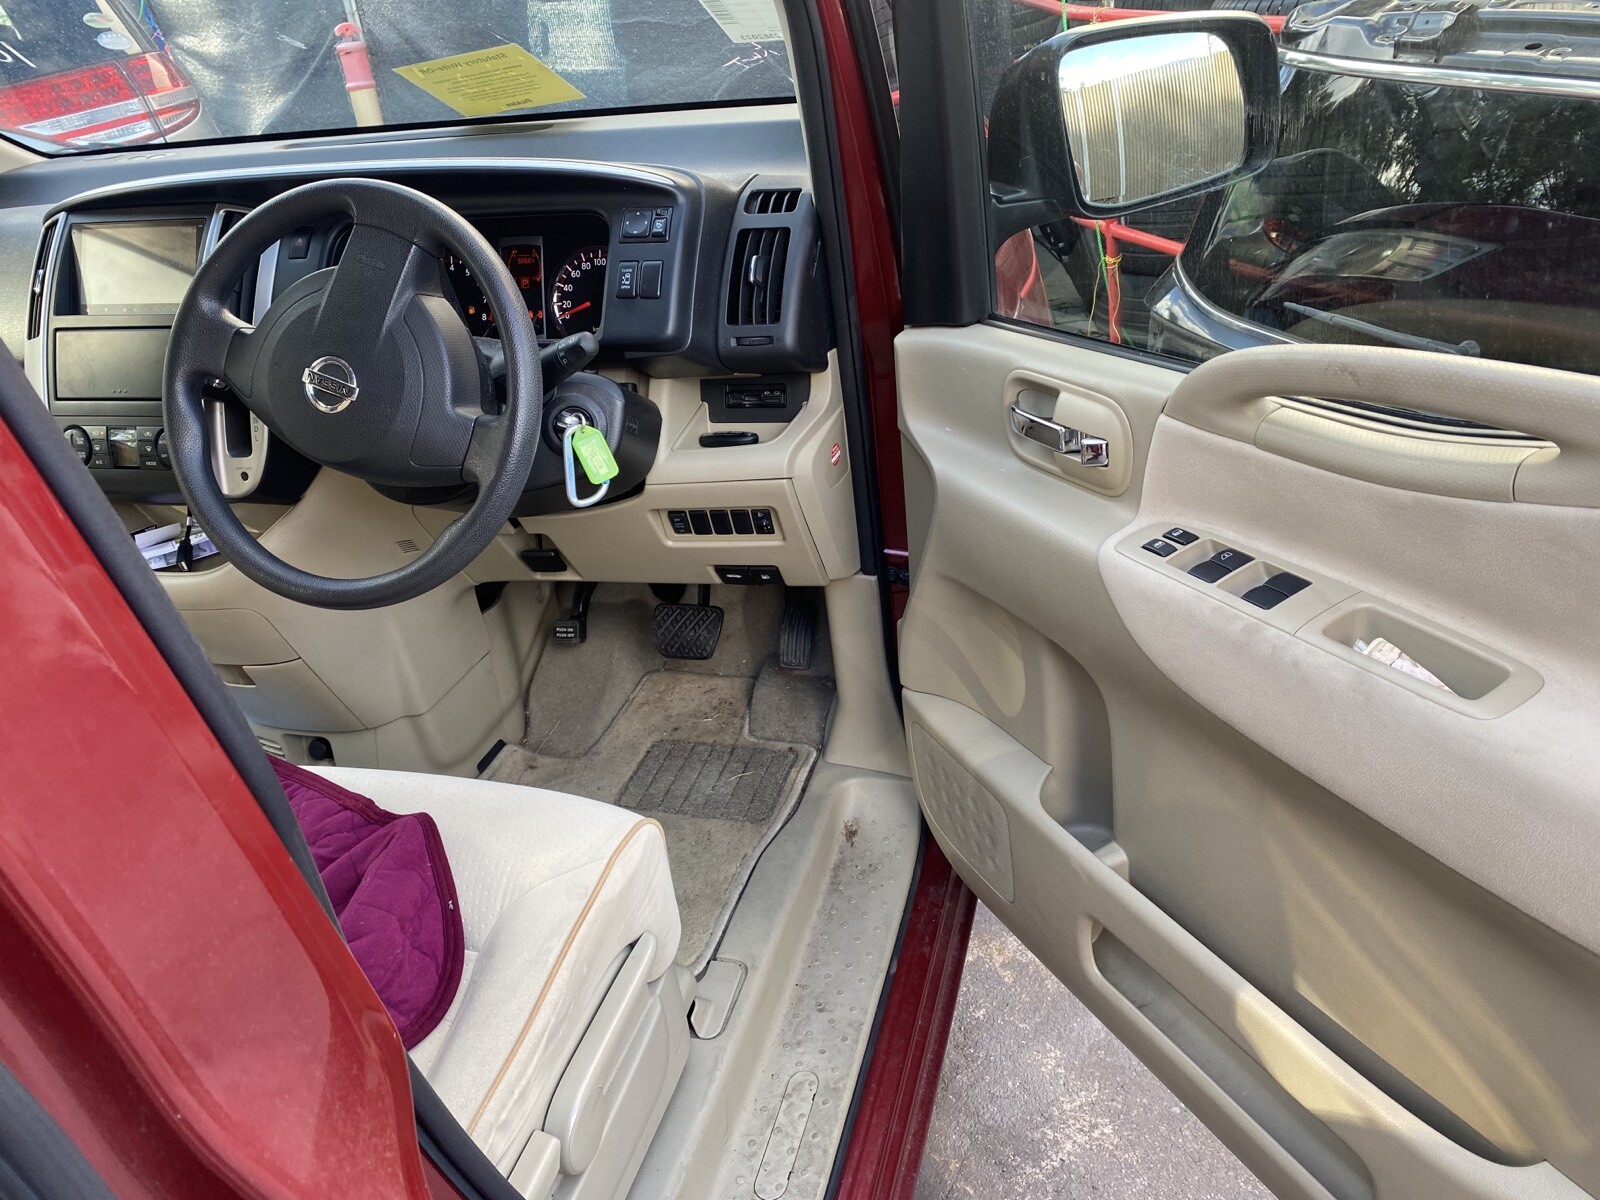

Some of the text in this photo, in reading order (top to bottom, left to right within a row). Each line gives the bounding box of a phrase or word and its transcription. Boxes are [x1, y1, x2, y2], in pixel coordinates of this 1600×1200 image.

[580, 262, 592, 270] 80
[593, 258, 607, 266] 100
[449, 264, 455, 272] 4
[465, 268, 471, 276] 5
[570, 270, 581, 278] 60
[563, 284, 573, 292] 40
[562, 300, 572, 308] 20
[481, 313, 487, 321] 8
[307, 371, 351, 395] NISSAN
[253, 425, 259, 433] D
